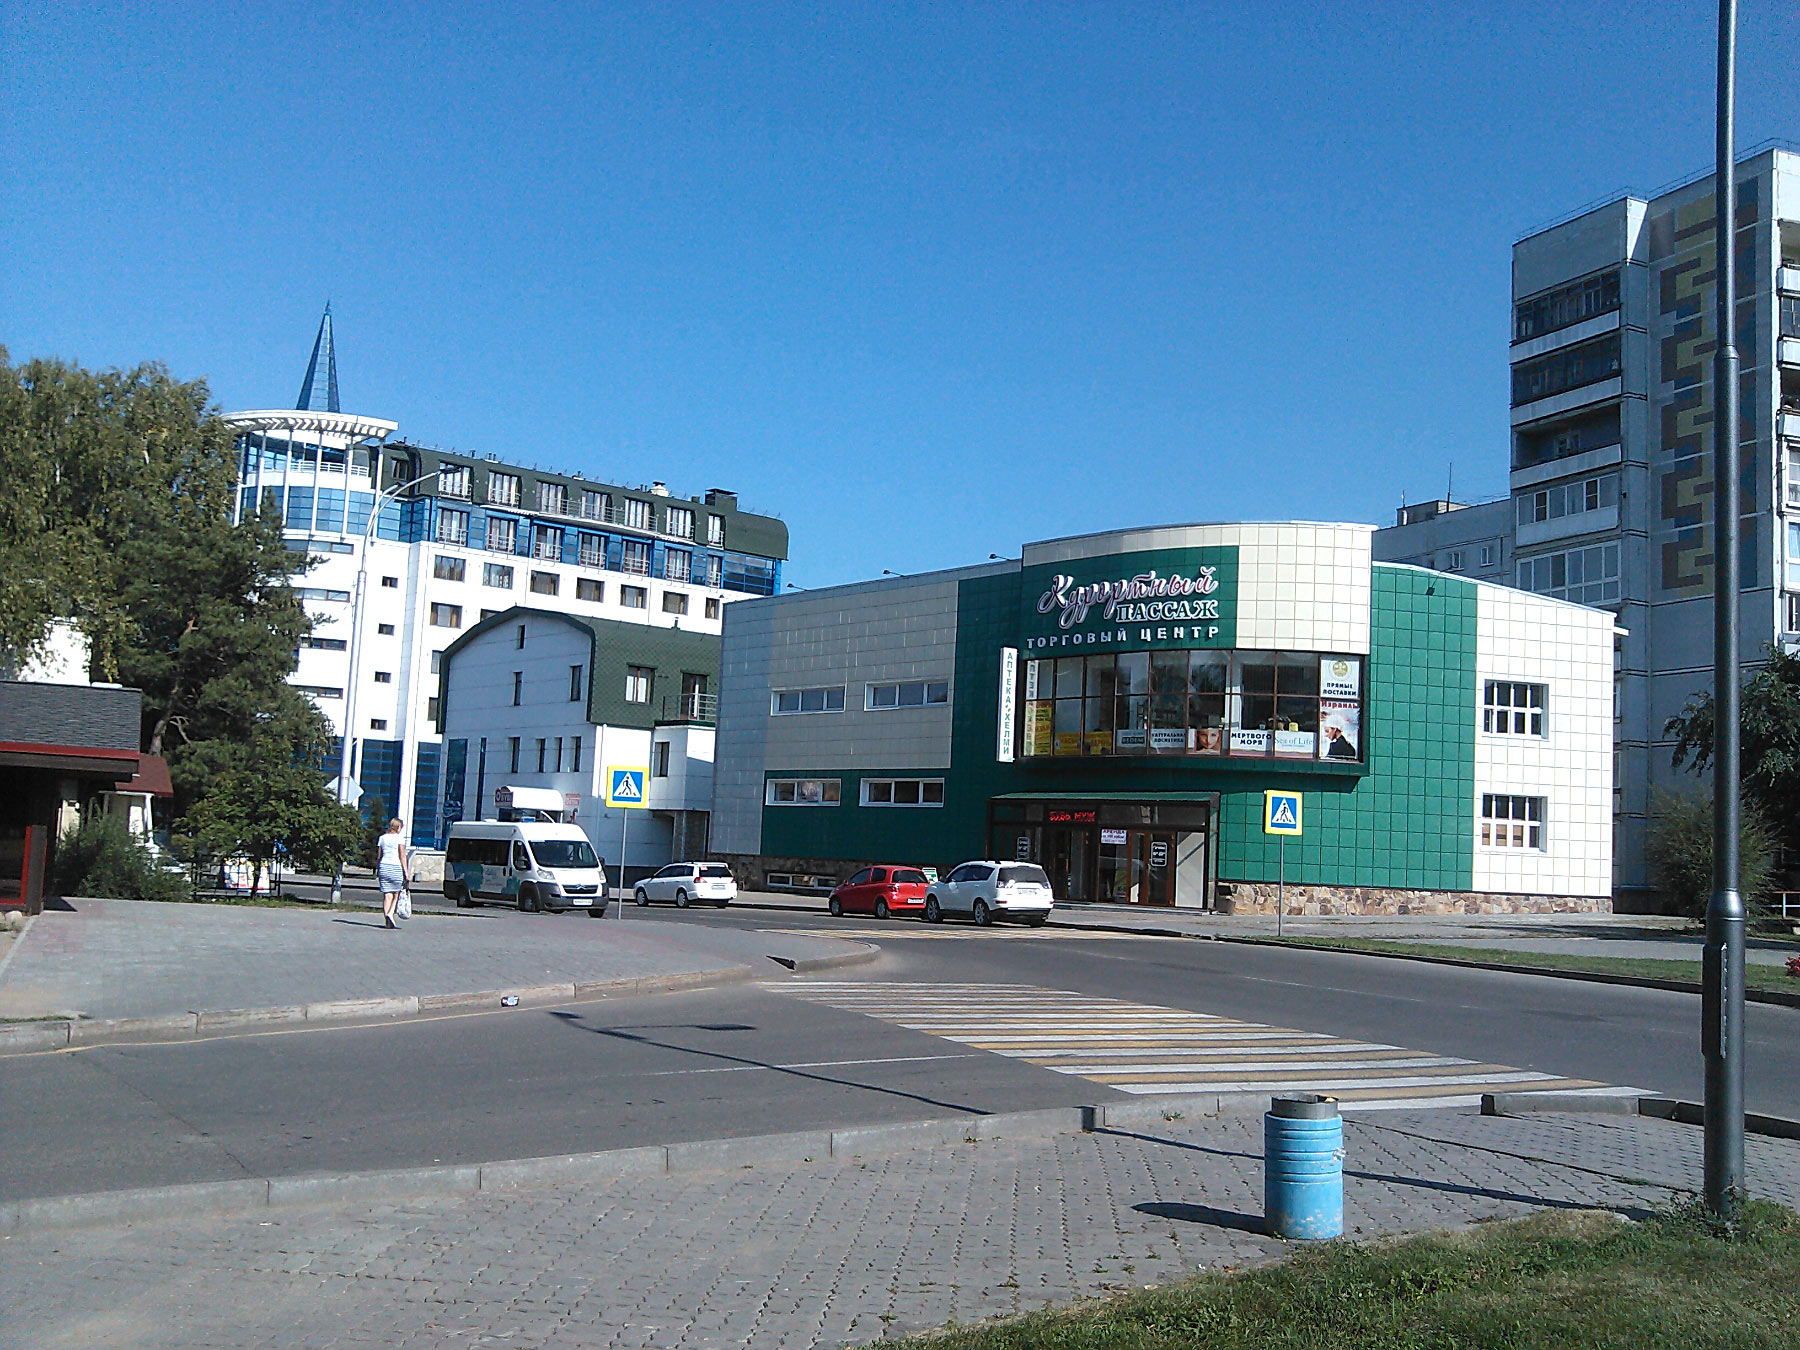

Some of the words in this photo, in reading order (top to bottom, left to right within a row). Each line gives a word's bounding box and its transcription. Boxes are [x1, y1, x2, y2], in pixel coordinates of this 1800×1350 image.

[1037, 566, 1219, 629] Курортный
[1116, 600, 1219, 623] ПАССАЖ
[1027, 628, 1128, 649] ТОРГОВЫЙ
[1140, 626, 1219, 642] ЦЕНТР
[1005, 652, 1013, 703] АПТЕКА
[1321, 700, 1358, 709] Израиль
[1003, 713, 1011, 754] ХЕЛМИ
[1288, 737, 1297, 745] of
[1298, 737, 1313, 745] Life
